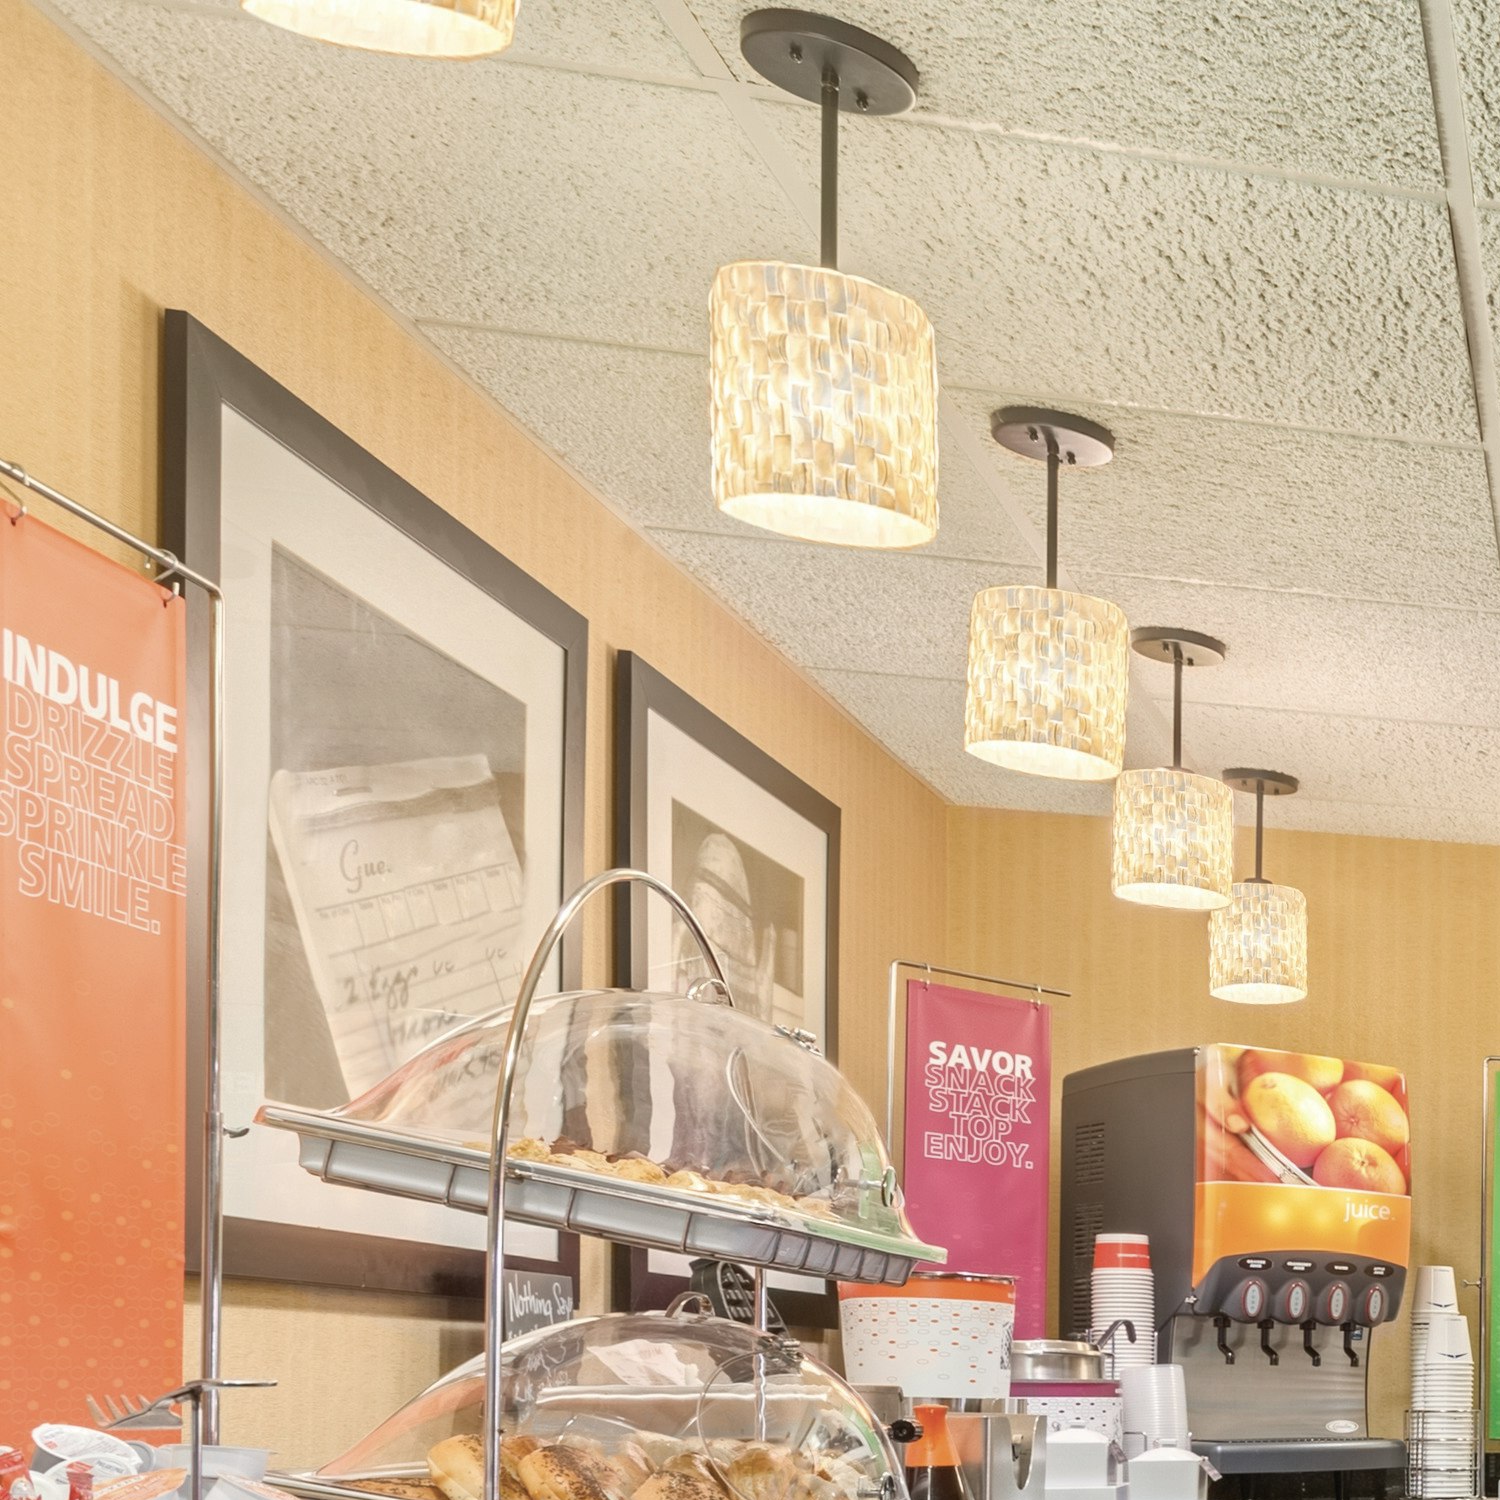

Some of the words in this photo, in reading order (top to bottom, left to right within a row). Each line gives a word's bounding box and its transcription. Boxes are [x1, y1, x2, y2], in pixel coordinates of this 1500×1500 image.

[3, 628, 177, 753] INDULGE
[7, 680, 173, 799] DRIZZLE
[5, 731, 175, 842] SPREAD
[0, 778, 186, 897] SPRINKLE
[18, 842, 160, 935] SMILE.
[925, 1062, 1036, 1102] SNACK
[929, 1041, 1033, 1079] SAVOR
[929, 1087, 1031, 1124] STACK
[949, 1112, 1012, 1141] TOP
[924, 1131, 1033, 1169] ENJOY.
[1344, 1198, 1391, 1222] juice
[508, 1273, 554, 1325] Nothing
